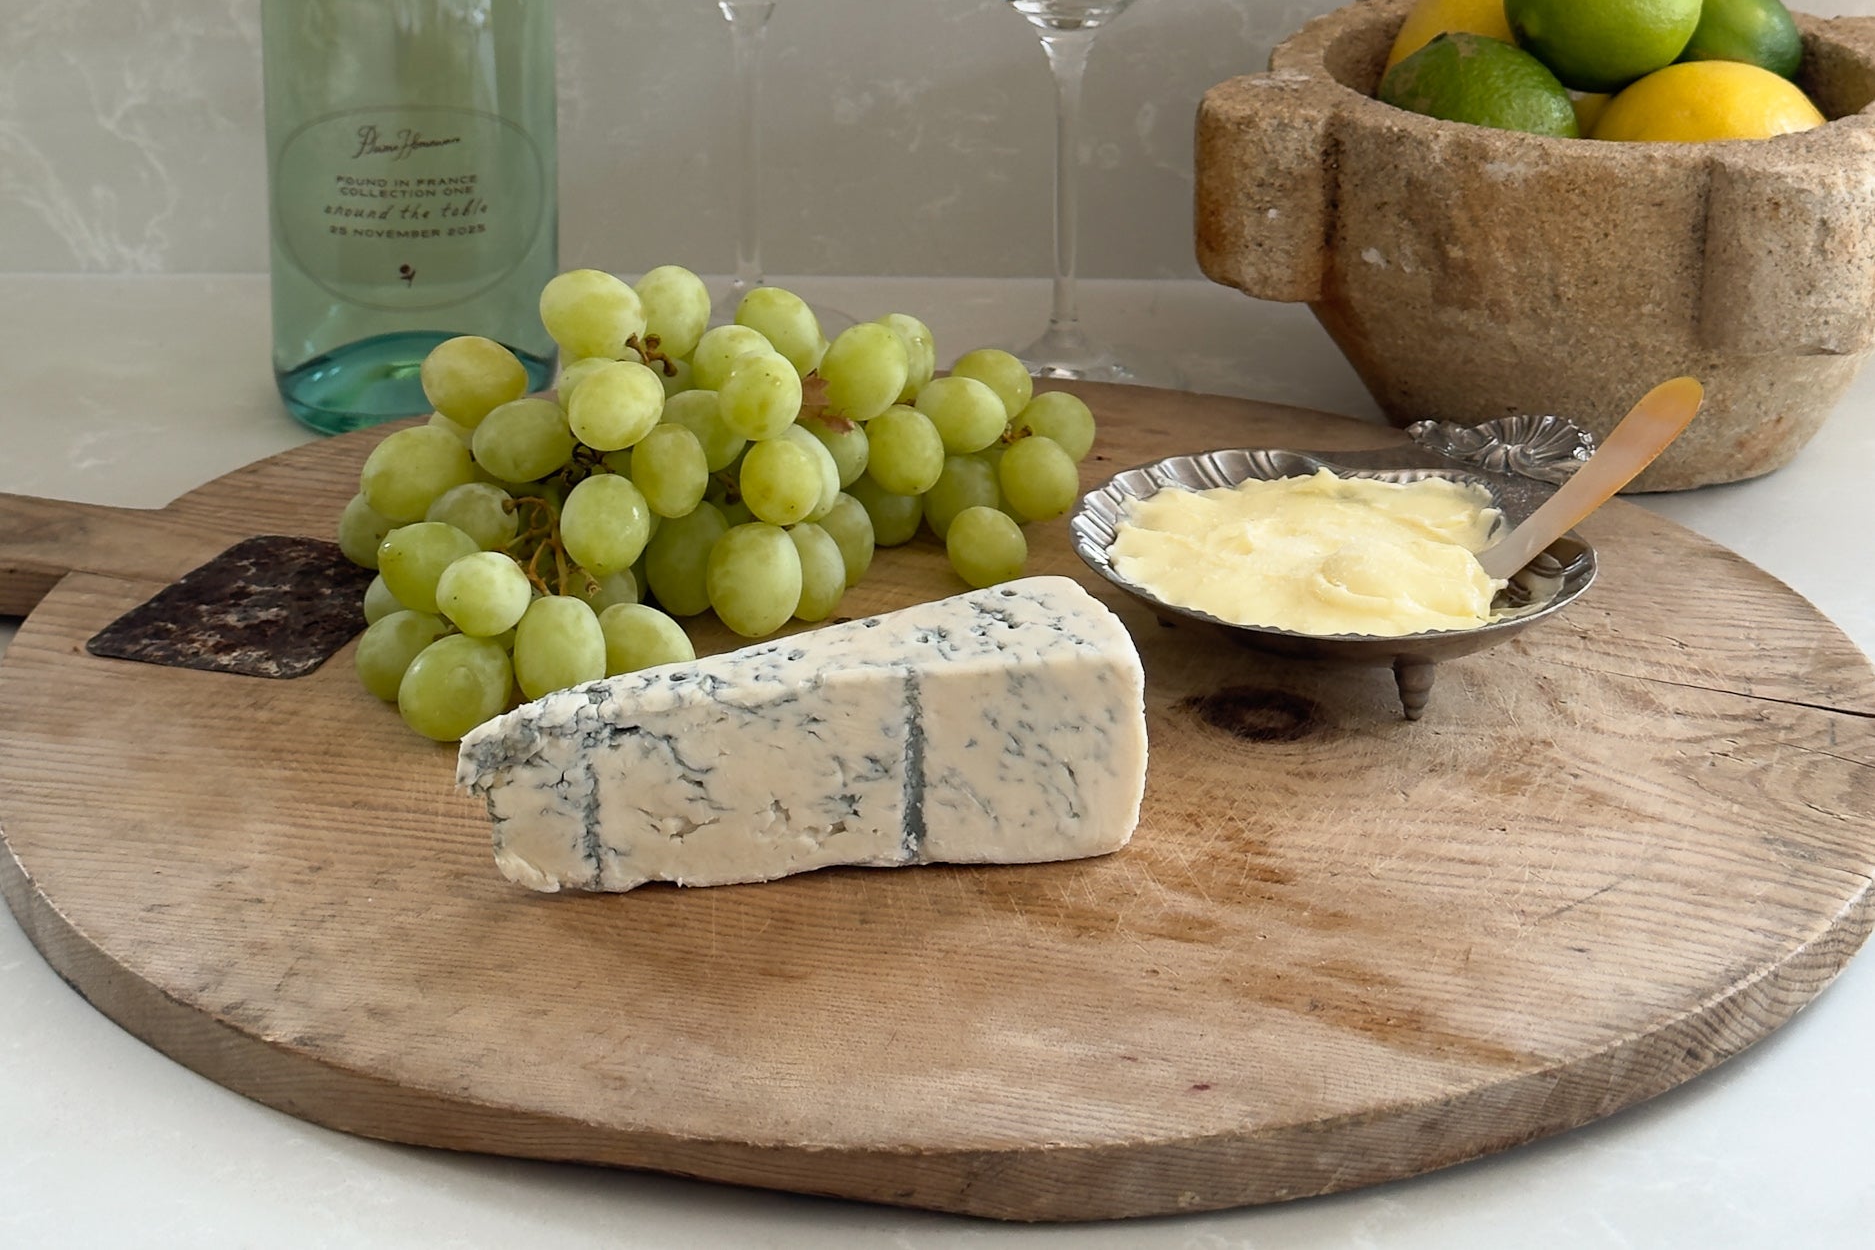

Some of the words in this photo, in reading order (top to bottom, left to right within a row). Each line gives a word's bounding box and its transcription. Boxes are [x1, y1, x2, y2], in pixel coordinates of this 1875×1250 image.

[336, 175, 388, 188] FOUND
[393, 177, 410, 187] IN
[416, 174, 478, 186] FRANCE
[339, 186, 436, 198] COLLECTION
[444, 186, 474, 197] ONE
[324, 203, 394, 220] around
[399, 205, 431, 220] the
[353, 227, 441, 239] NOVEMBER
[447, 224, 486, 237] 2025
